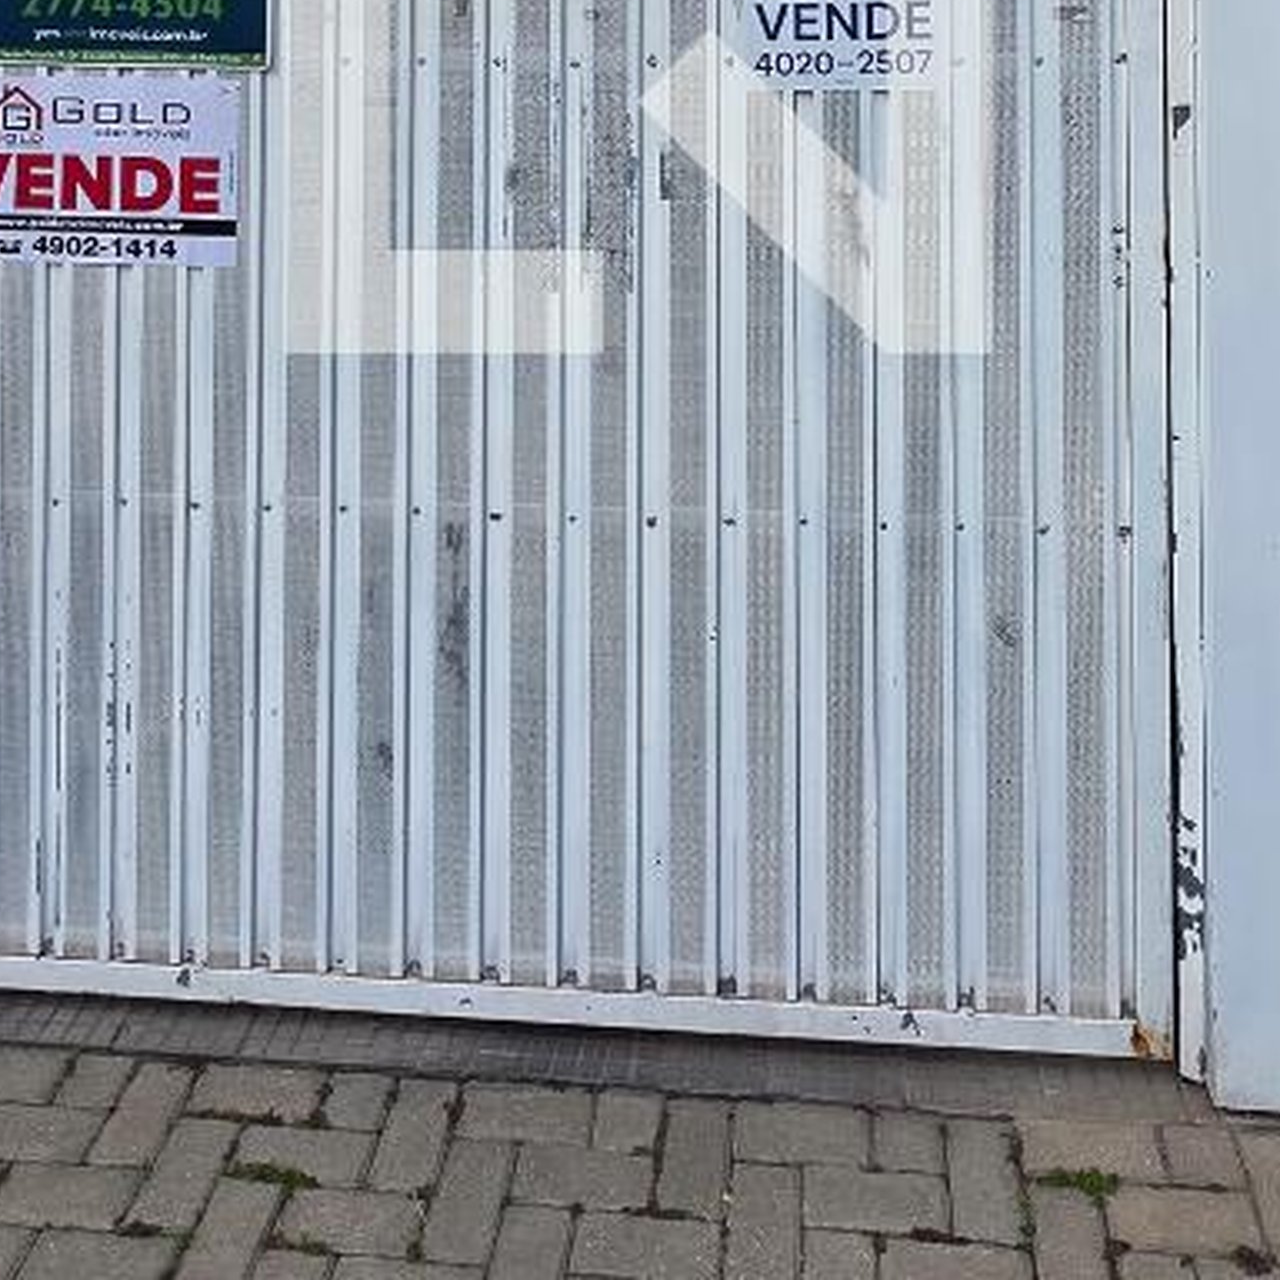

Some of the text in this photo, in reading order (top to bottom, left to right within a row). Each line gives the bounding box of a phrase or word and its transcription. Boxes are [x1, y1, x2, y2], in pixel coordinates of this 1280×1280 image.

[754, 1, 933, 41] VENDE
[753, 49, 933, 76] 4020-2507
[52, 97, 192, 124] GOLD
[32, 235, 178, 258] 4902-1414
